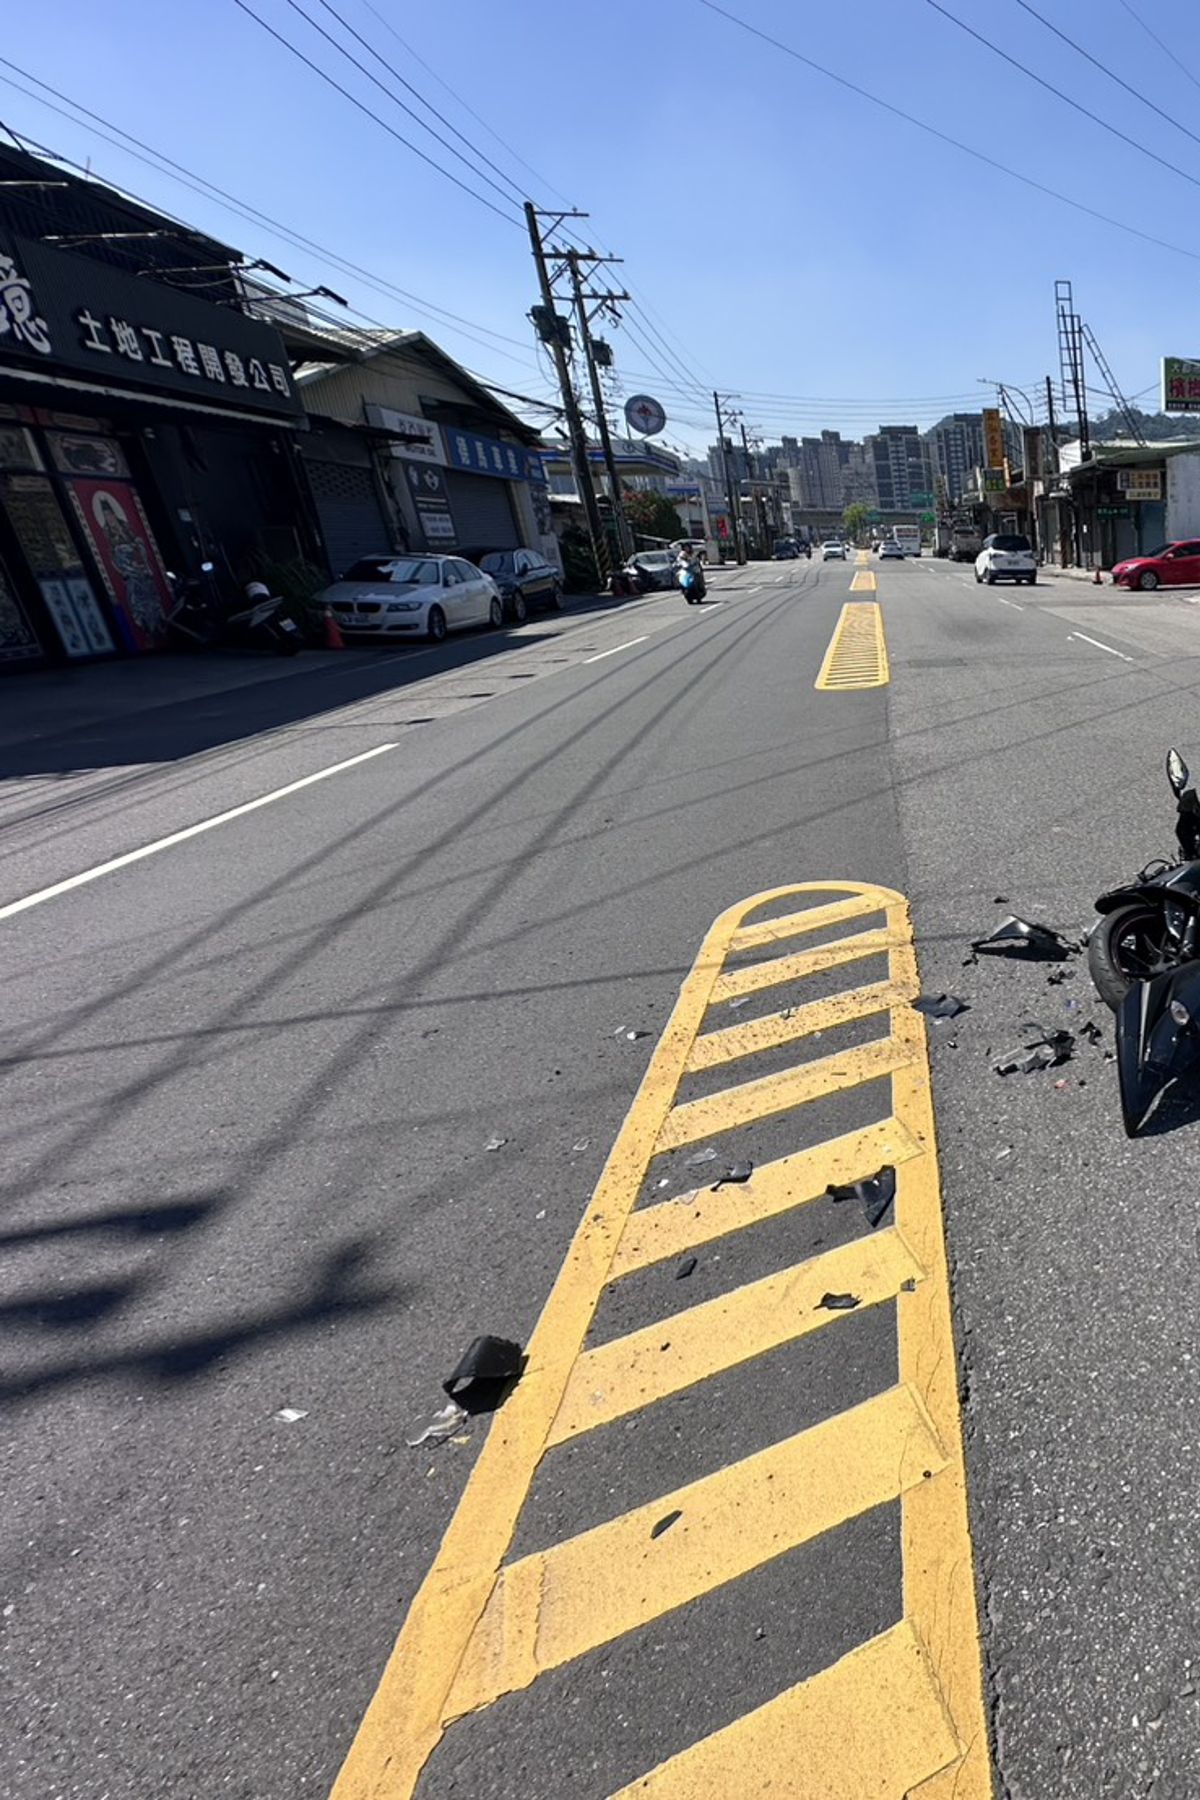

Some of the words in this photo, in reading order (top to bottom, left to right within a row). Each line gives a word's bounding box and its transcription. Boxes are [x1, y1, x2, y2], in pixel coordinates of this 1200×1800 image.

[78, 309, 291, 398] 土地工程開發公司
